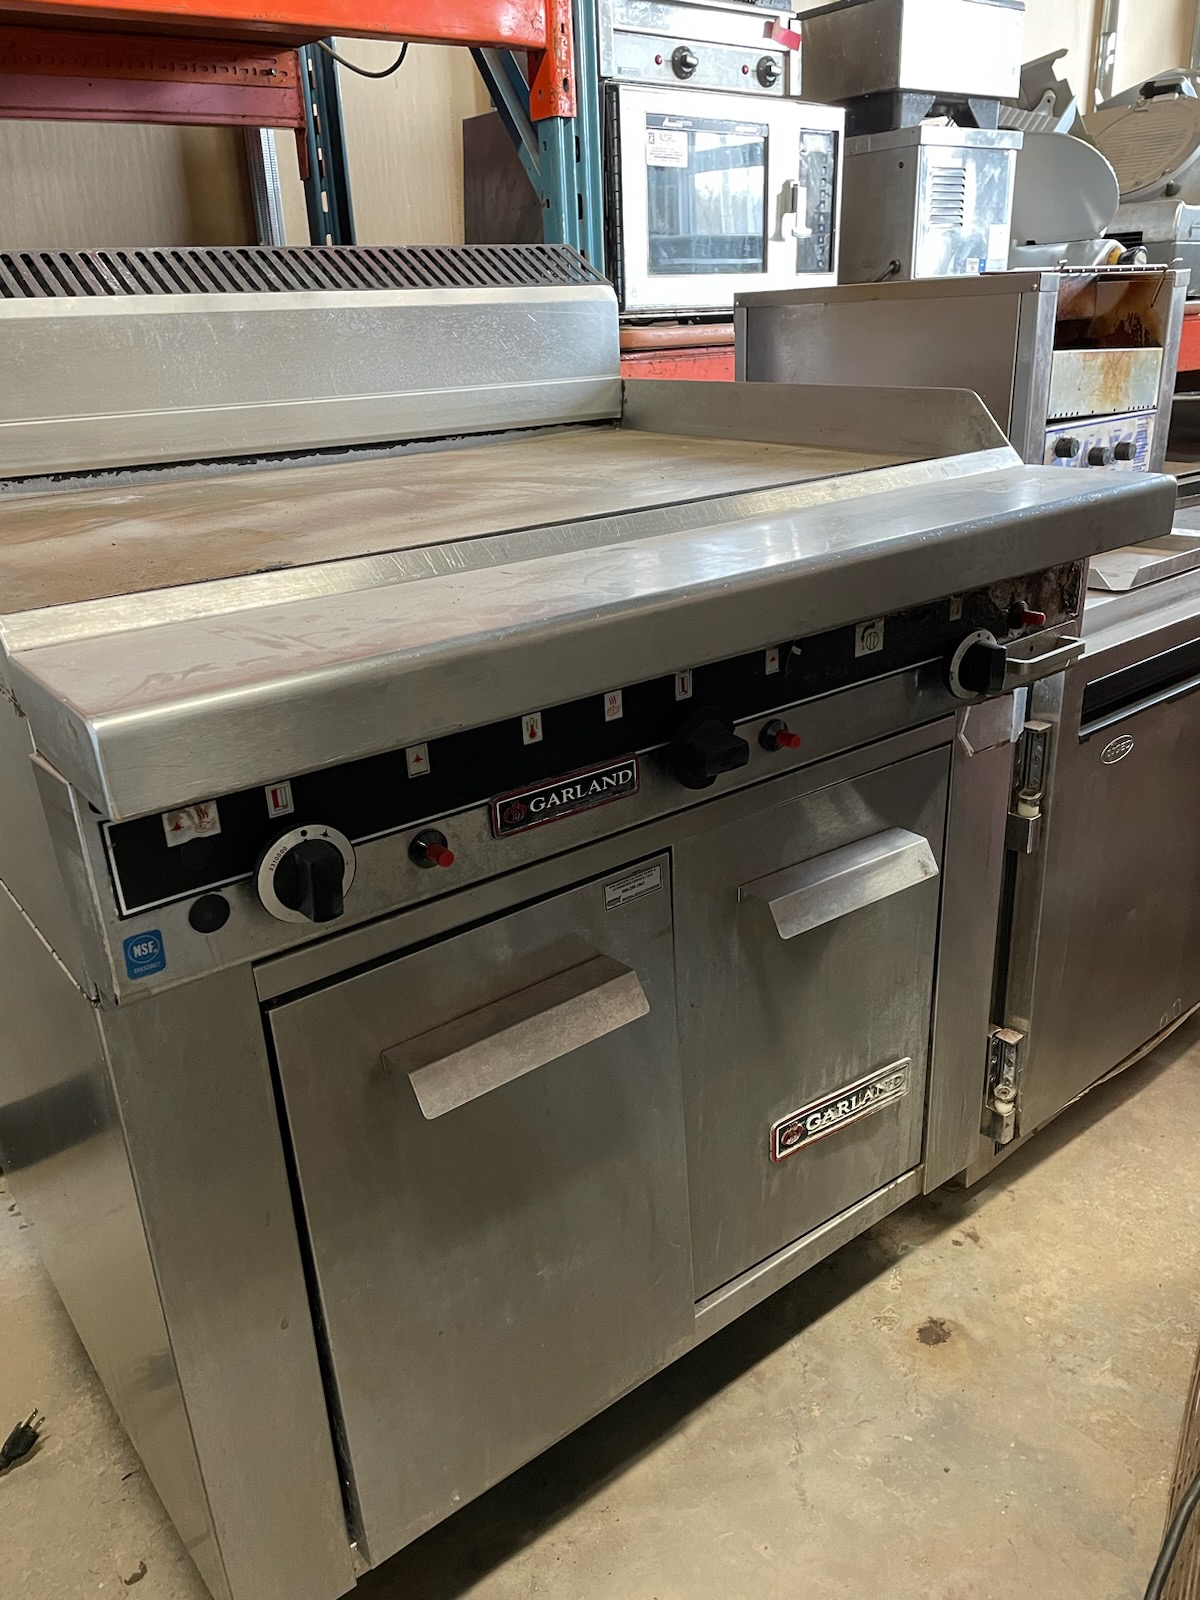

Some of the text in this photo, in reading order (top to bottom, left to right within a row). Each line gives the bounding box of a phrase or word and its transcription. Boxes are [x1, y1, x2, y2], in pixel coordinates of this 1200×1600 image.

[529, 769, 632, 812] GARLAND
[132, 940, 155, 958] NSF
[806, 1073, 904, 1131] GARLAND
